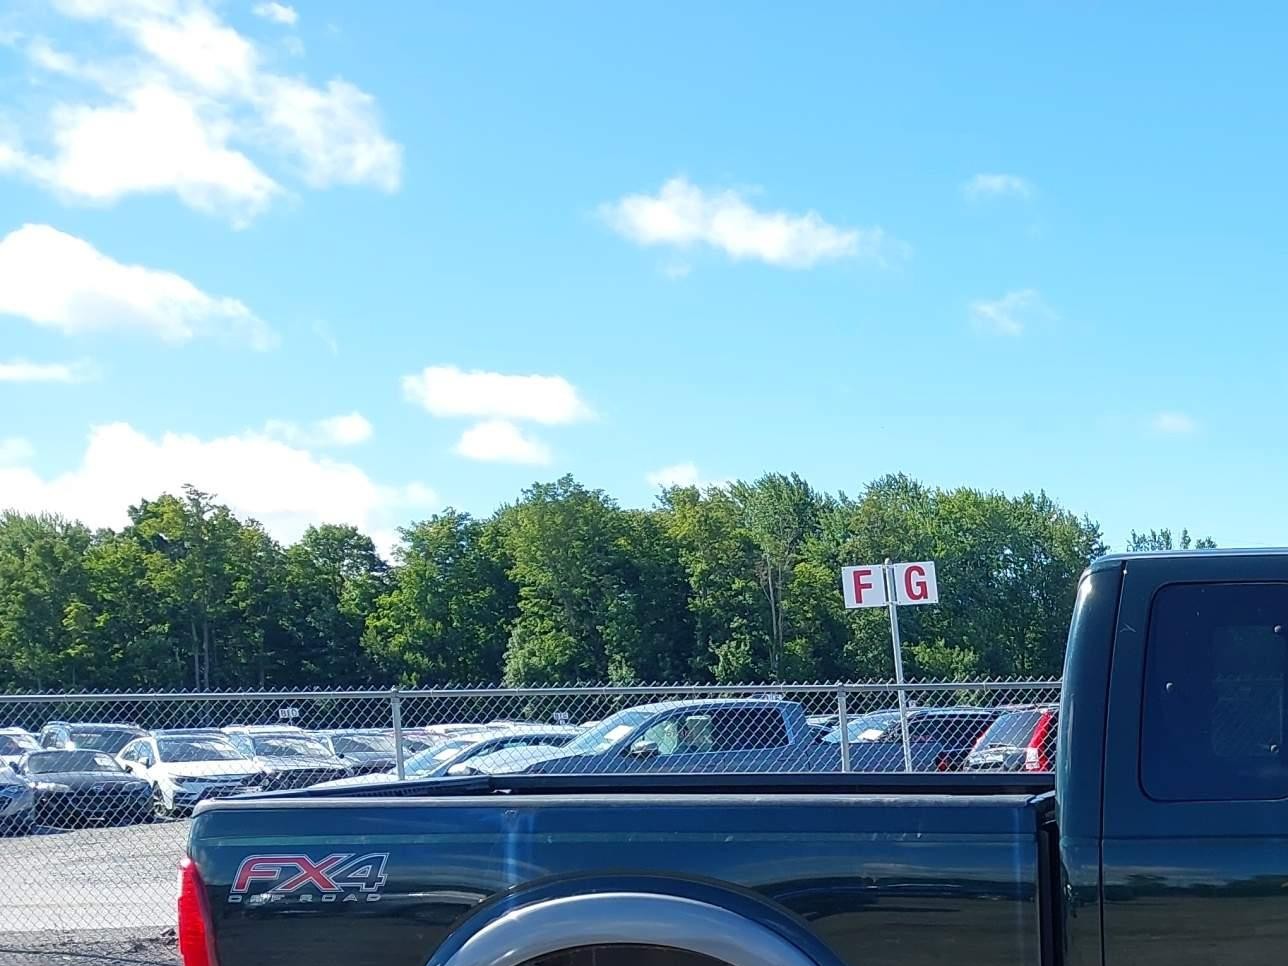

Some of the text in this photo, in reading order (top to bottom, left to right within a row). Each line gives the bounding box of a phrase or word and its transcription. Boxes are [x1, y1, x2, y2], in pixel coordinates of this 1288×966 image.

[853, 565, 928, 604] F G
[230, 852, 389, 893] FX4
[299, 893, 382, 903] ROAD
